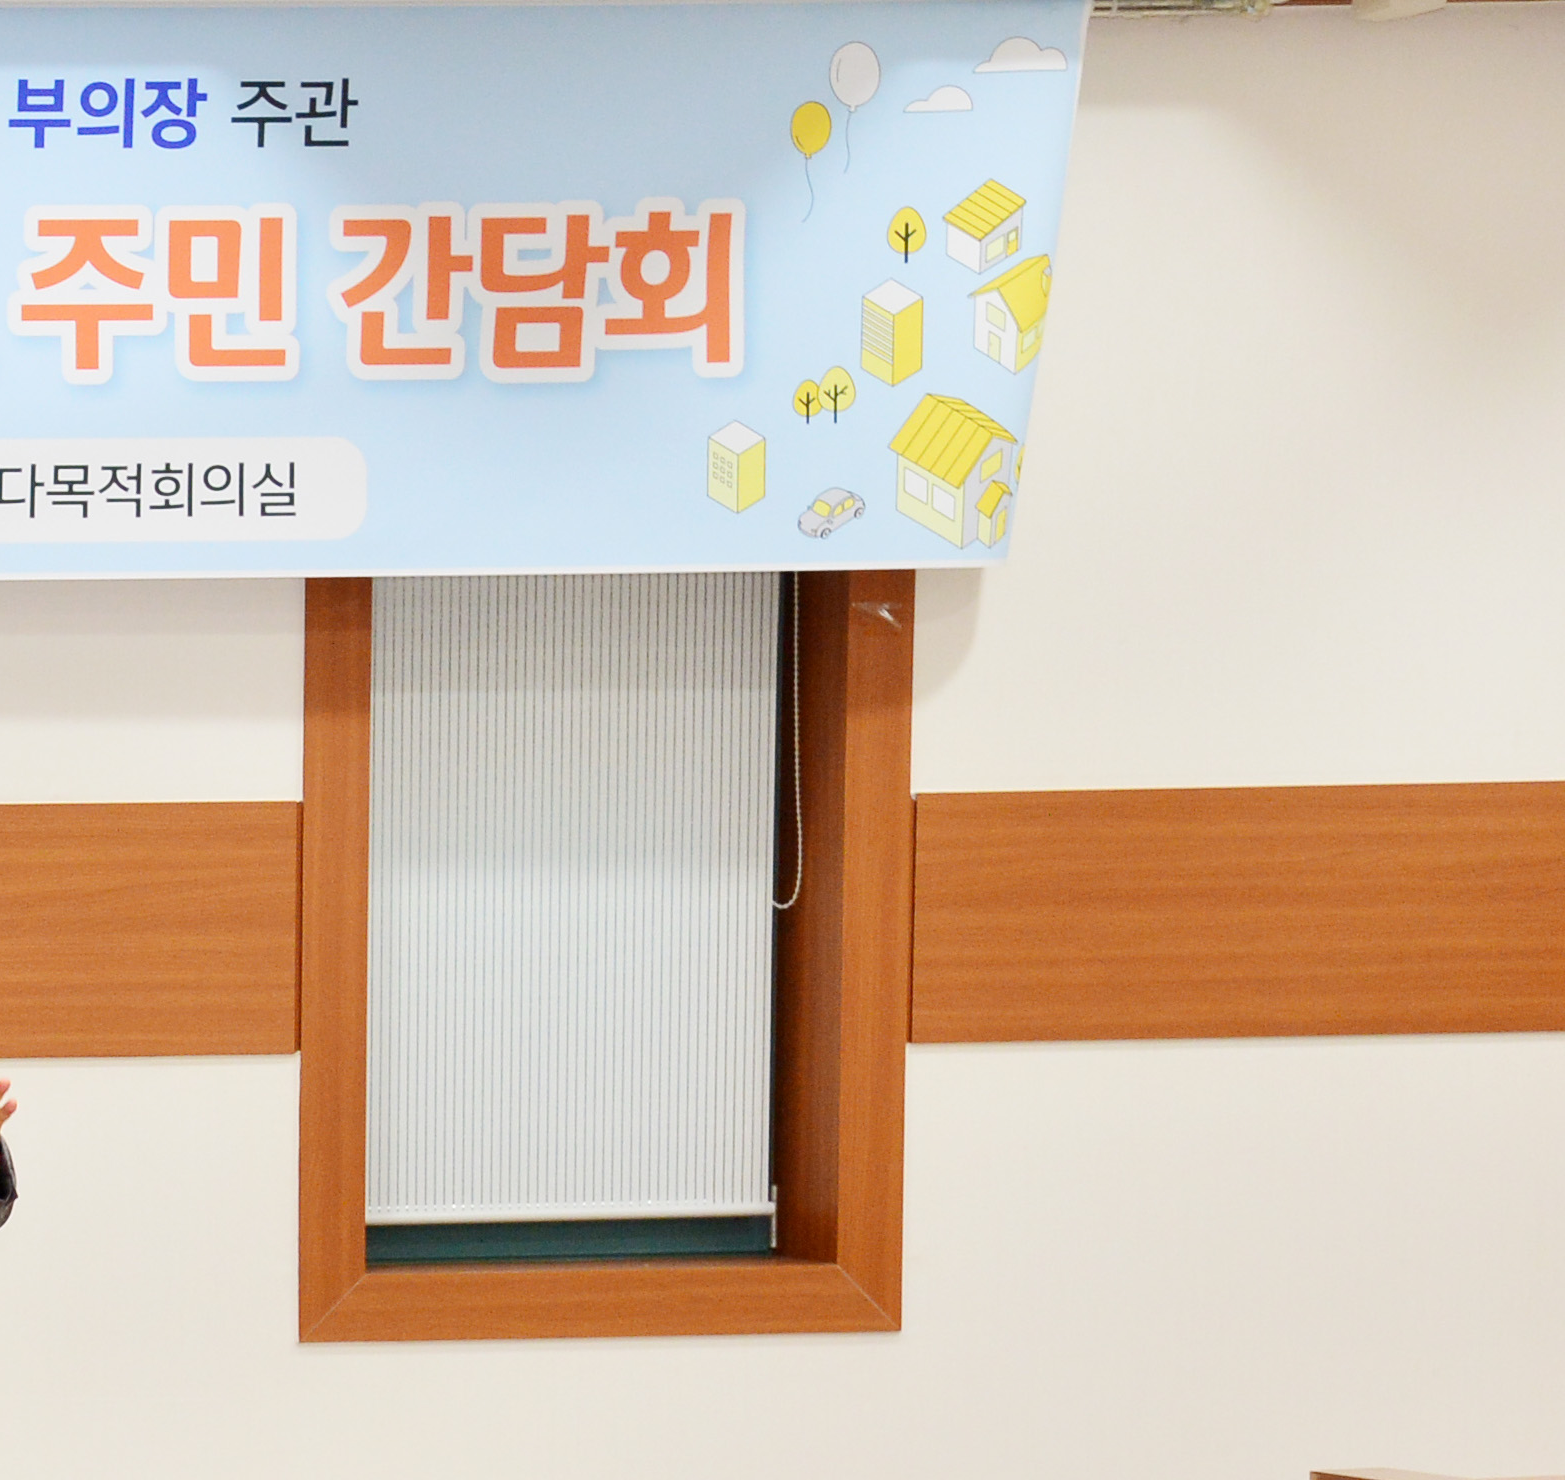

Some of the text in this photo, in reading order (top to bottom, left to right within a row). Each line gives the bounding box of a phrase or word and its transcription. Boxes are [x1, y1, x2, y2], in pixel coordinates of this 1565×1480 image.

[9, 78, 207, 148] 부의장
[231, 78, 358, 147] 주관
[21, 217, 287, 370] 주민
[341, 210, 733, 369] 간담회
